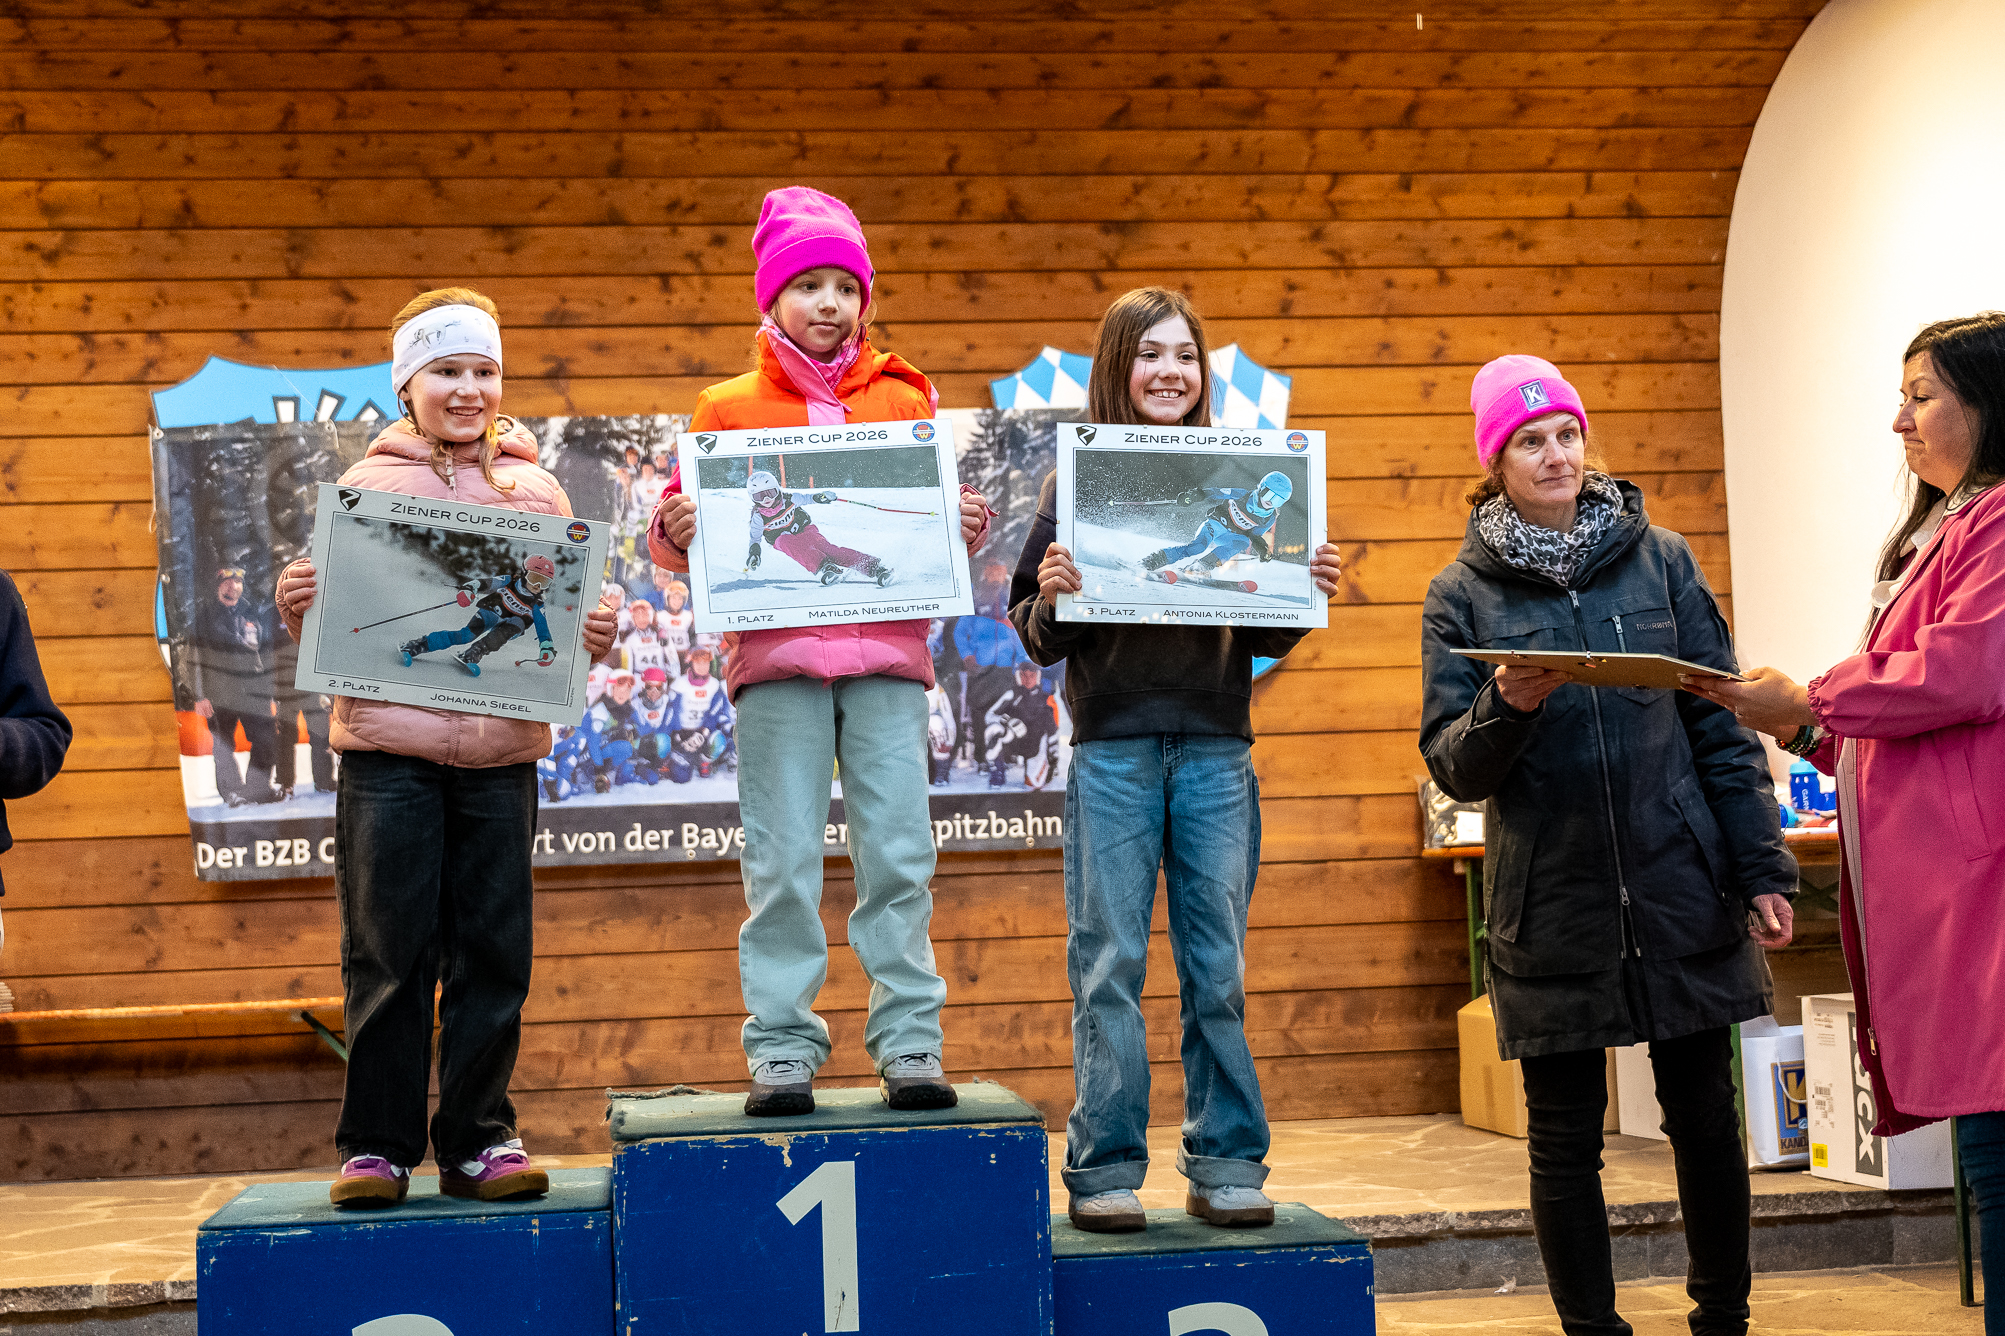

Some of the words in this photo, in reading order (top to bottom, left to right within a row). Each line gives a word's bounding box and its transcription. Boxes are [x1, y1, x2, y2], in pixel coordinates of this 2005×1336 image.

[1526, 386, 1543, 404] K
[747, 436, 804, 447] ZIENER
[808, 432, 842, 444] CUP
[845, 430, 888, 442] 2026
[1124, 433, 1180, 444] ZIENER
[1184, 434, 1218, 446] CUP
[1220, 435, 1262, 447] 2026
[390, 502, 451, 520] ZIENER
[456, 511, 492, 525] CUP
[495, 517, 540, 533] 2026
[738, 614, 774, 624] PLATZ
[808, 608, 859, 619] MATILDA
[862, 603, 940, 616] NEUREUTHER
[1087, 607, 1098, 616] 3.
[1100, 607, 1136, 616] PLATZ
[1163, 608, 1213, 618] ANTONIA
[1215, 610, 1299, 620] KLOSTERMANN
[328, 679, 340, 690] 2.
[343, 681, 381, 694] PLATZ
[430, 693, 487, 708] JOHANNA
[490, 699, 532, 714] SIEGEL
[197, 842, 248, 869] Der
[255, 838, 311, 867] BZB
[561, 832, 616, 853] von
[623, 823, 674, 851] der
[932, 809, 1063, 848] pitzbahn
[776, 1161, 859, 1333] 1
